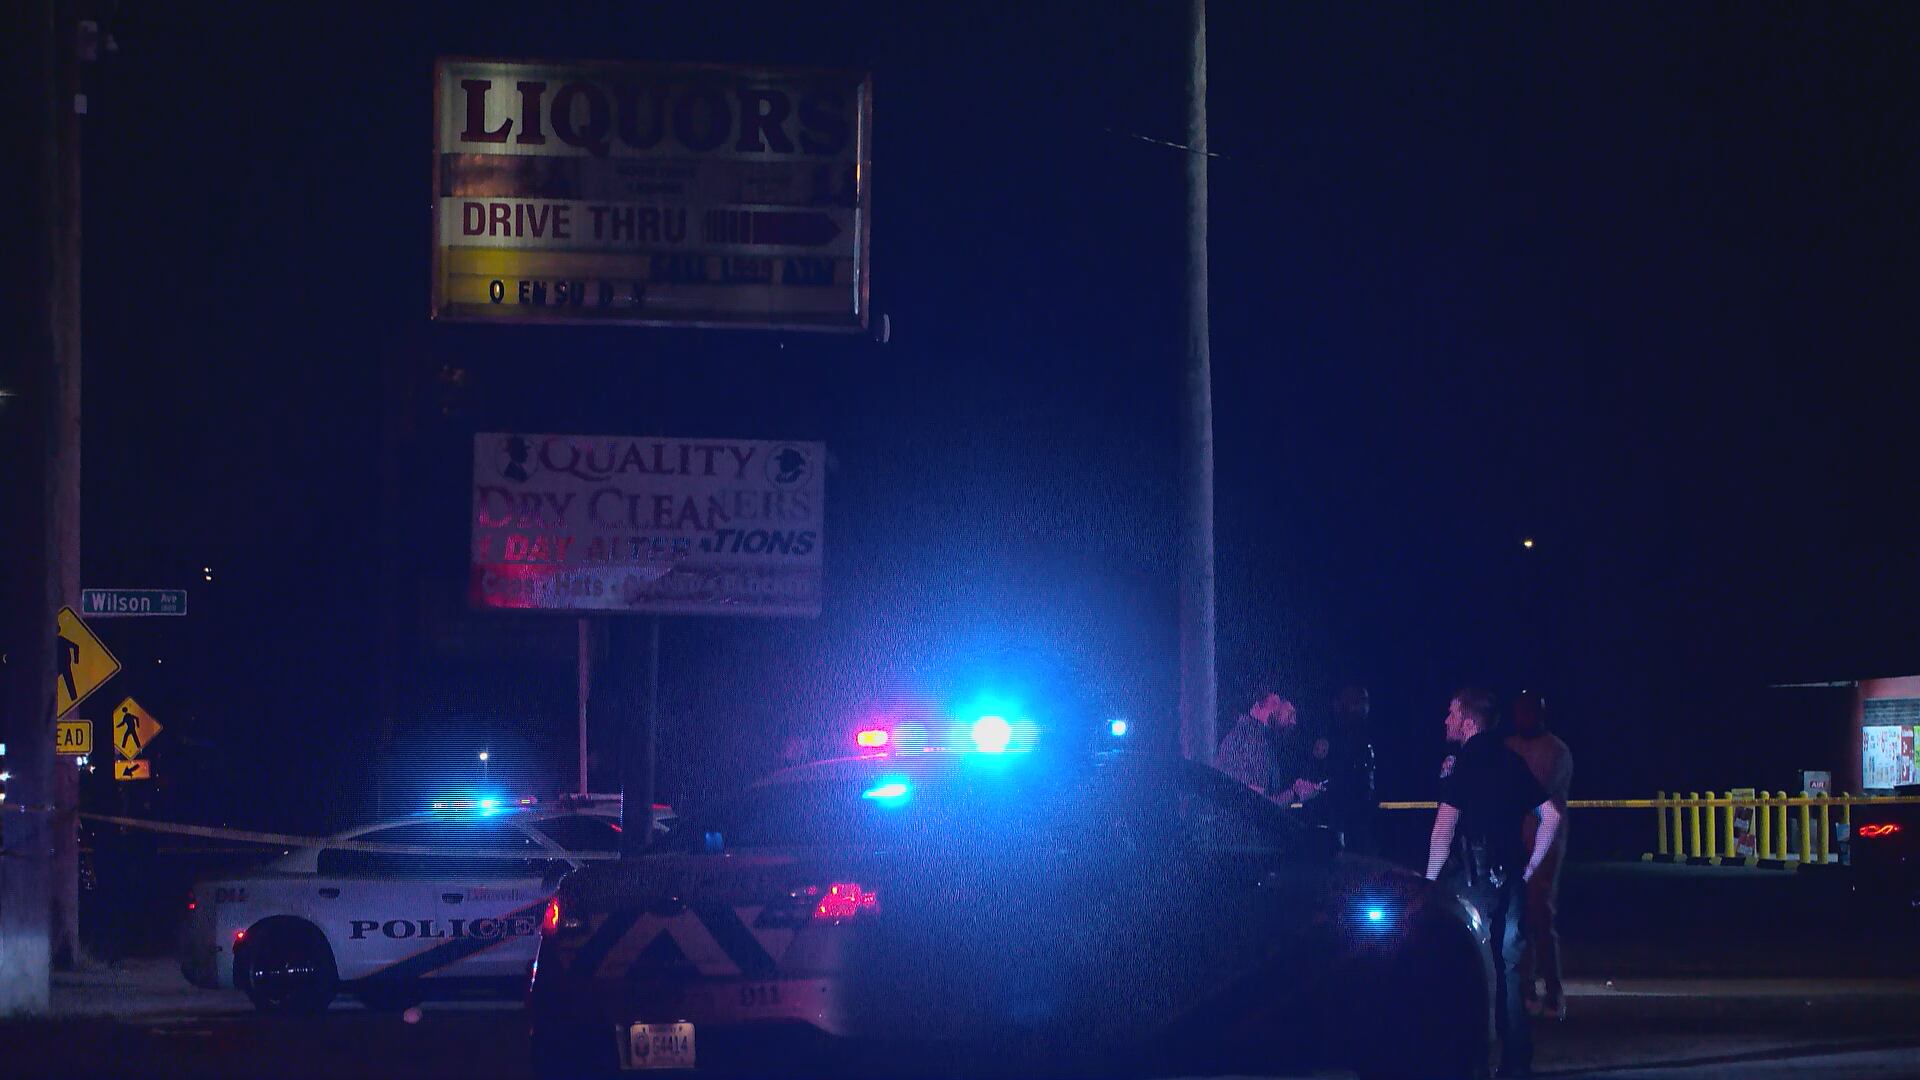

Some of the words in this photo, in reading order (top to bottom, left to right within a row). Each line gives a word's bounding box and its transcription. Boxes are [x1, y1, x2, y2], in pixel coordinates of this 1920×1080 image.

[460, 79, 850, 157] LIQUORS
[463, 202, 571, 239] DRIVE
[588, 205, 687, 243] THRU
[539, 434, 756, 482] QUALITY
[478, 486, 576, 530] DRY
[587, 487, 812, 532] CLEANERS
[504, 534, 576, 561] DAY
[91, 592, 151, 612] Wilson
[160, 593, 178, 603] Ave
[56, 728, 84, 746] EAD
[1810, 780, 1826, 789] AIR
[349, 917, 537, 939] POLICE
